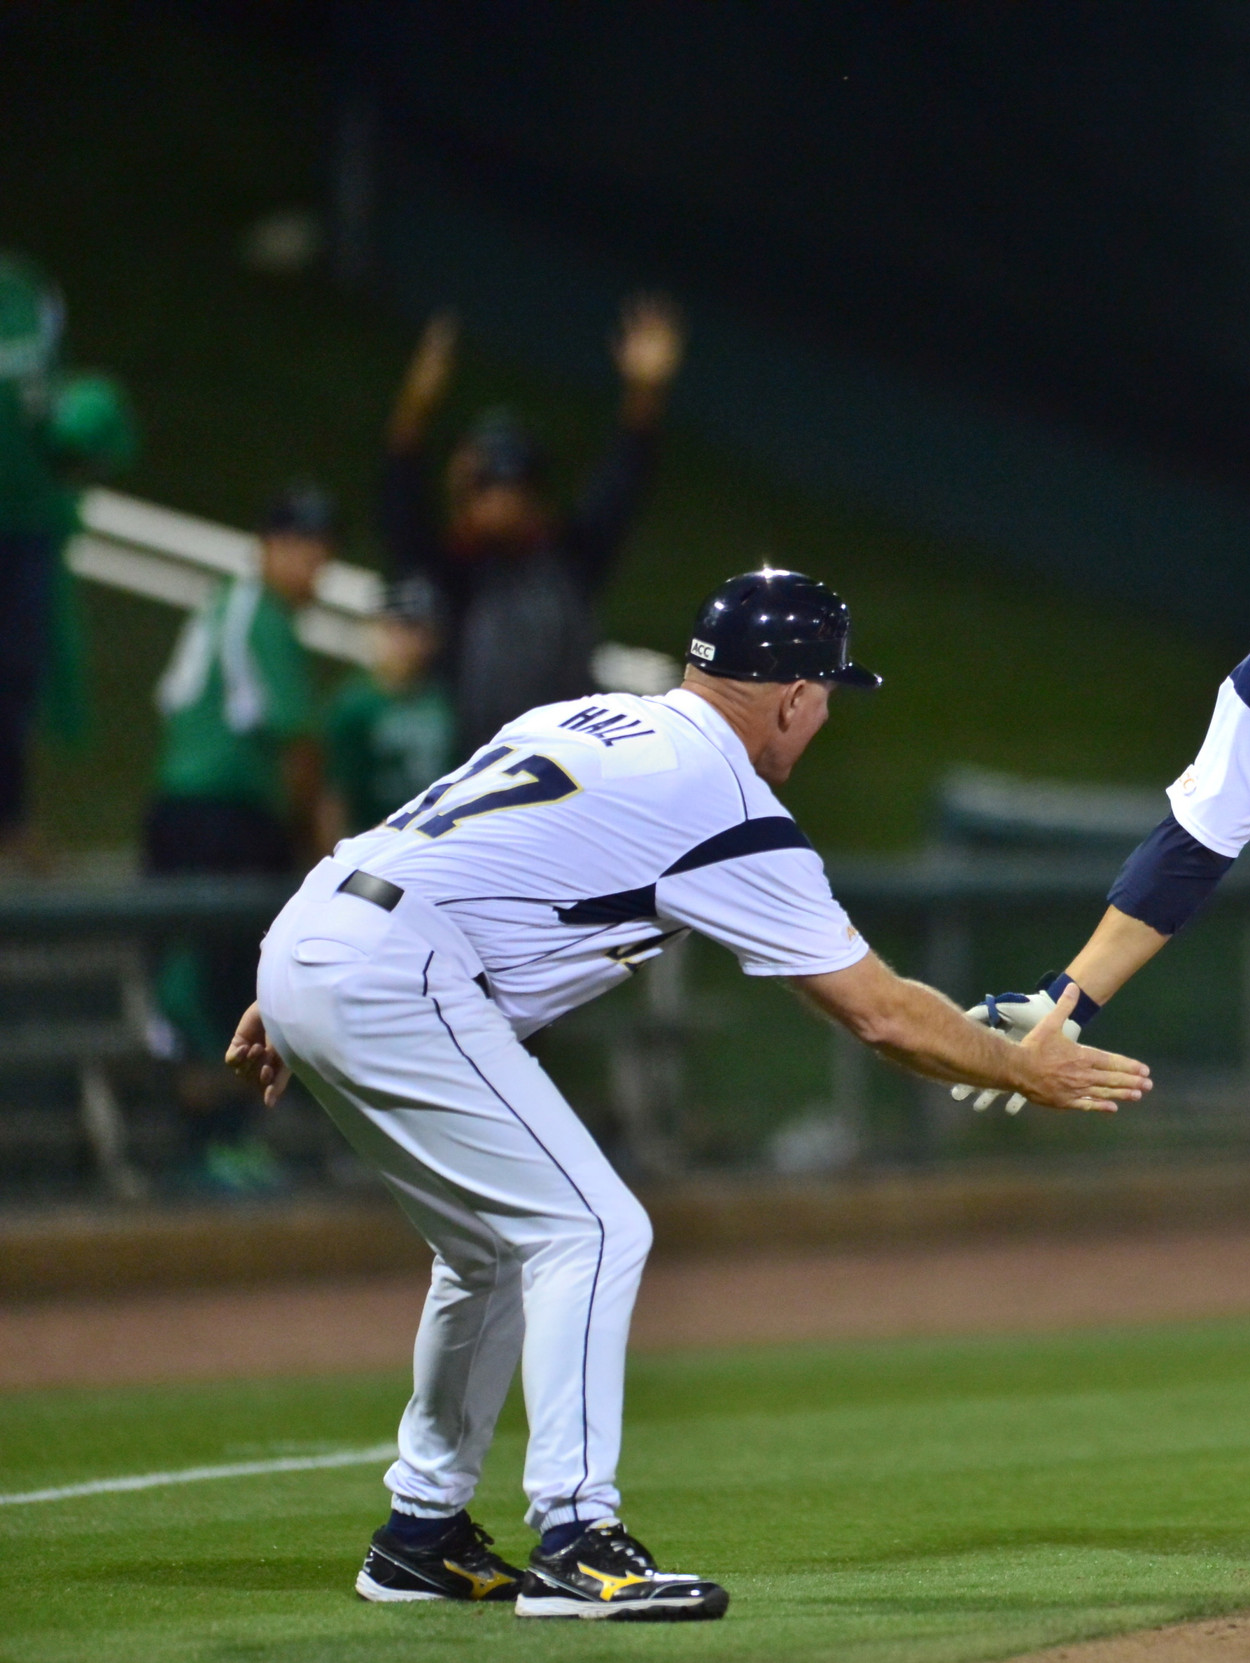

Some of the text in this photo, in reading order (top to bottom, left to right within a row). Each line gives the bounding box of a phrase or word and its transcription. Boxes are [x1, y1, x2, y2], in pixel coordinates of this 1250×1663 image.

[691, 642, 713, 658] ACC
[558, 705, 655, 747] HALL
[385, 744, 584, 839] 17
